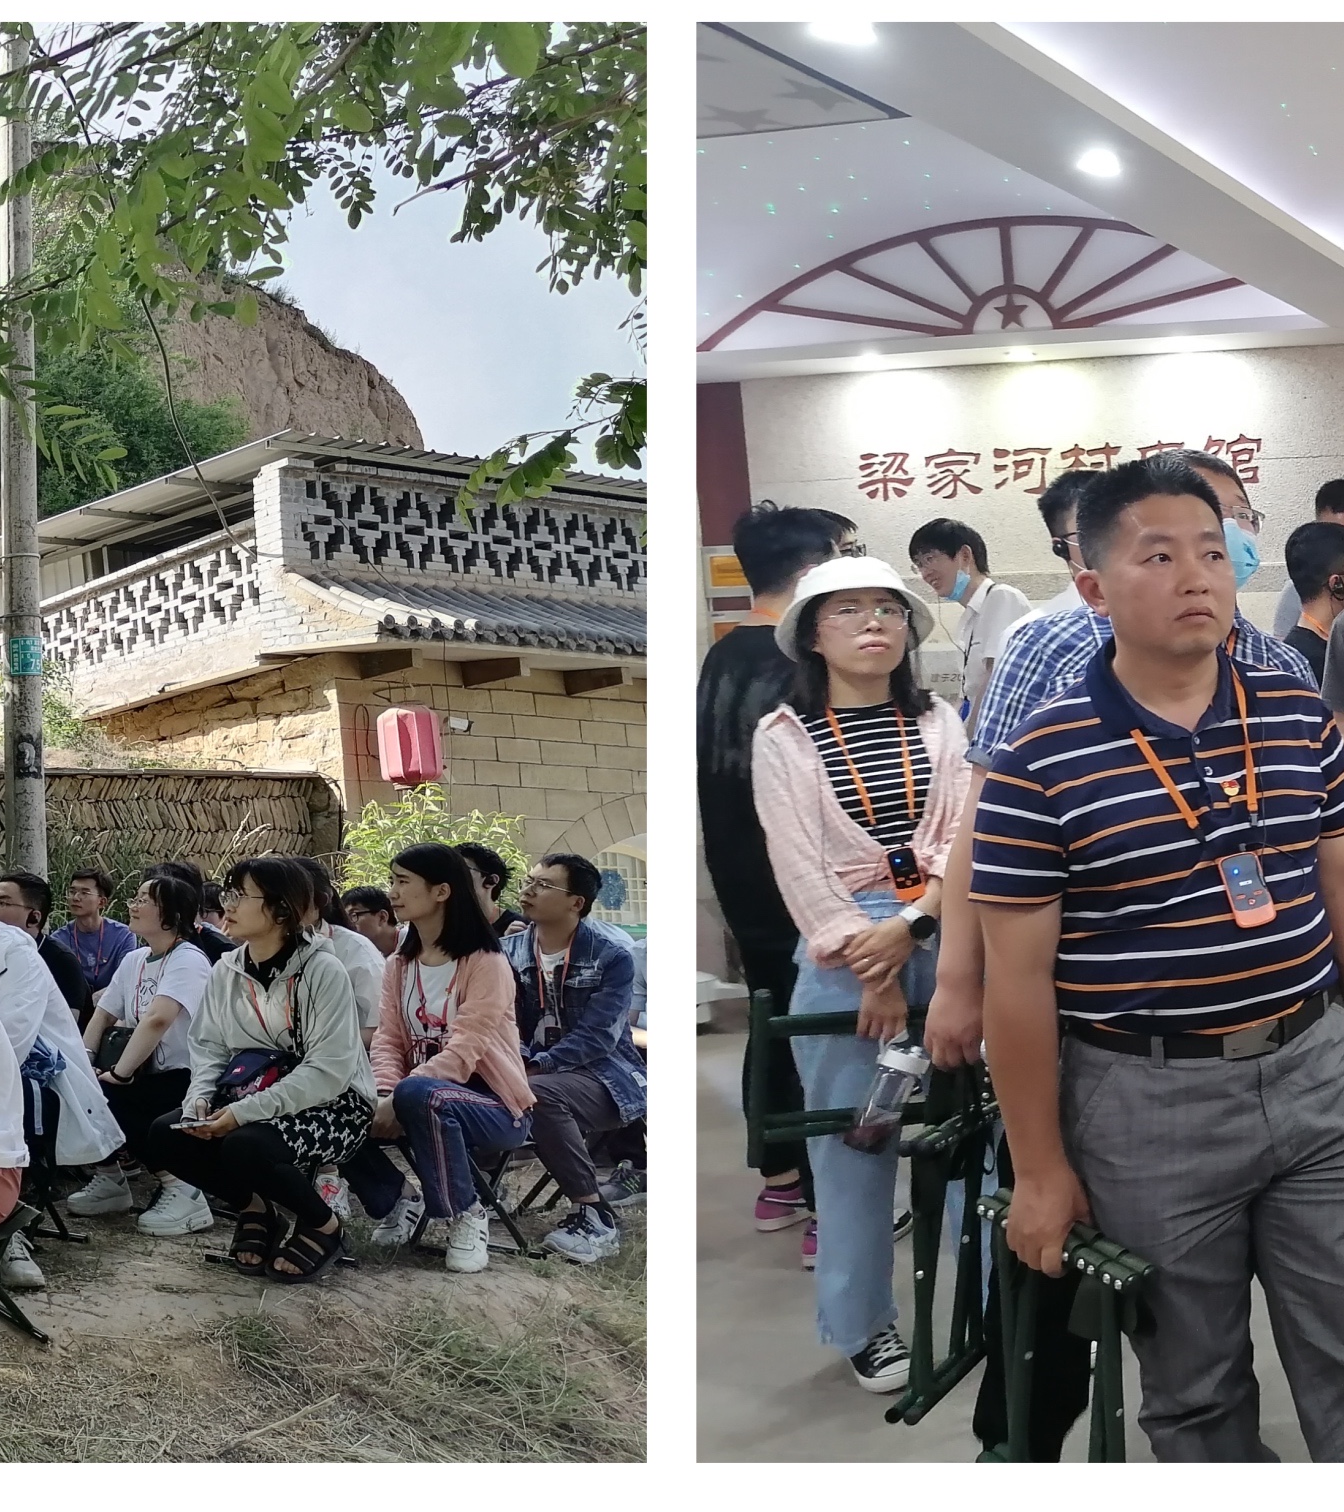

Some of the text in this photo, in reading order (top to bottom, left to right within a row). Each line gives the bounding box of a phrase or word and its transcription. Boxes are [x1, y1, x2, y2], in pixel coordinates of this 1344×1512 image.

[857, 432, 1263, 502] 梁家河村馆
